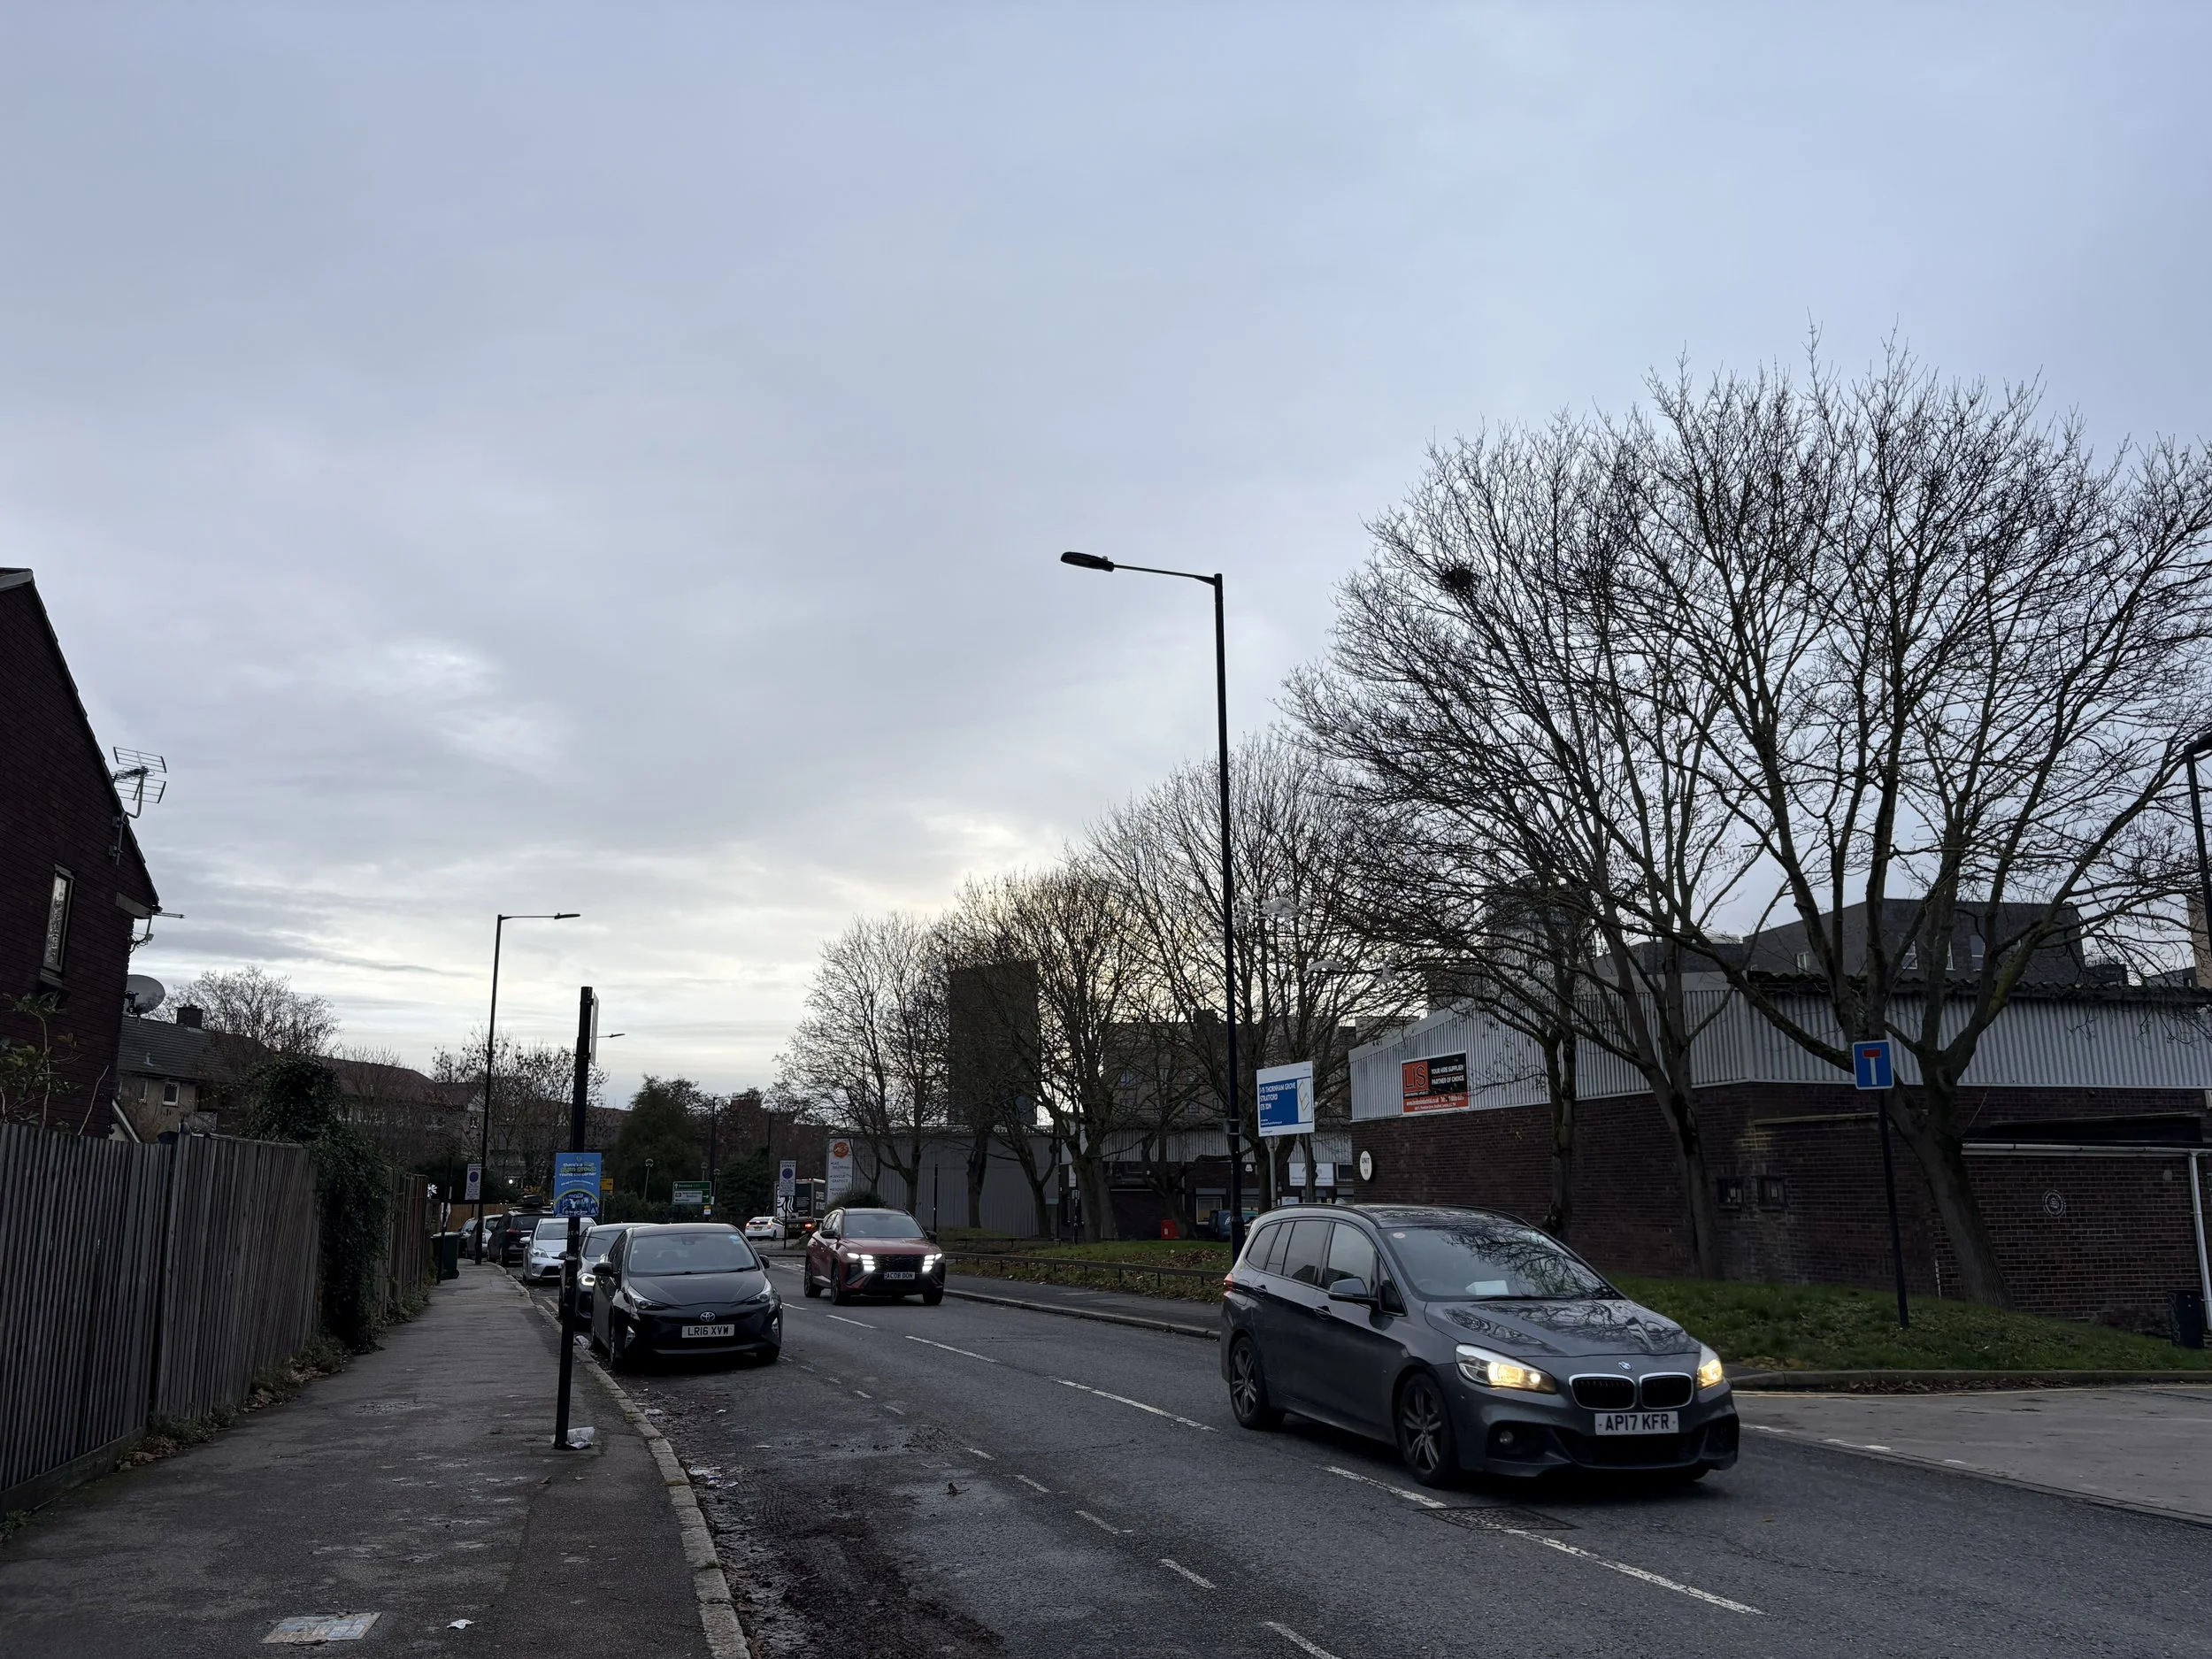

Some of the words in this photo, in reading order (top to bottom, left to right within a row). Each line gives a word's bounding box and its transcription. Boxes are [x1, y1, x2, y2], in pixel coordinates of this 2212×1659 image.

[1404, 1065, 1426, 1088] LIS
[1265, 1084, 1285, 1093] THORNHAM
[687, 1326, 709, 1336] LR16
[710, 1325, 729, 1335] XVW
[1605, 1415, 1638, 1431] AP17
[1642, 1414, 1670, 1430] KFR
